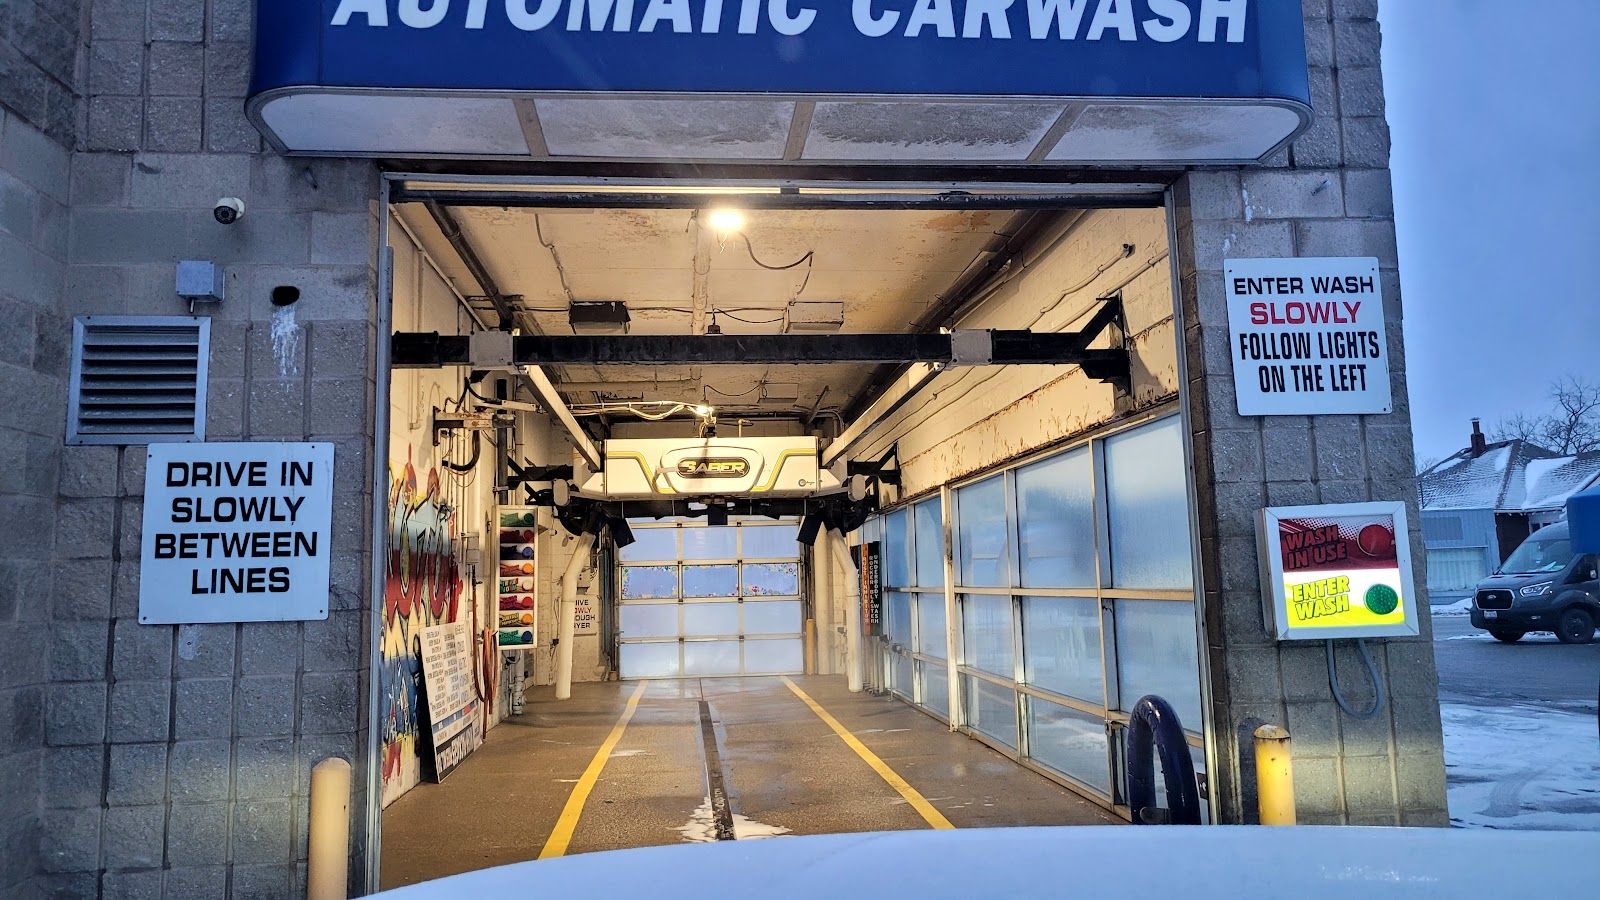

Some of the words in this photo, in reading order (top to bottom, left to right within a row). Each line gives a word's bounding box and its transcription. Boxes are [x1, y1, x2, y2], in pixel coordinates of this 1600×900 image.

[850, 0, 1248, 43] CARWASH
[1233, 277, 1304, 295] ENTER
[1310, 276, 1374, 294] WASH
[1250, 301, 1361, 325] SLOWLY
[1239, 332, 1311, 360] FOLLOW
[1317, 331, 1380, 359] LIGHTS
[1258, 365, 1286, 393] ON
[1290, 364, 1325, 392] THE
[1329, 364, 1367, 392] LEFT
[166, 461, 268, 487] DRIVE
[280, 461, 313, 486] IN
[679, 460, 745, 474] SABER
[171, 496, 306, 523] SLOWLY
[154, 531, 318, 559] BETWEEN
[1285, 524, 1339, 550] WASH
[1287, 549, 1309, 569] IN
[1312, 542, 1348, 564] USE
[191, 567, 290, 595] LINES
[1292, 575, 1350, 603] ENTER
[1295, 594, 1350, 621] WASH
